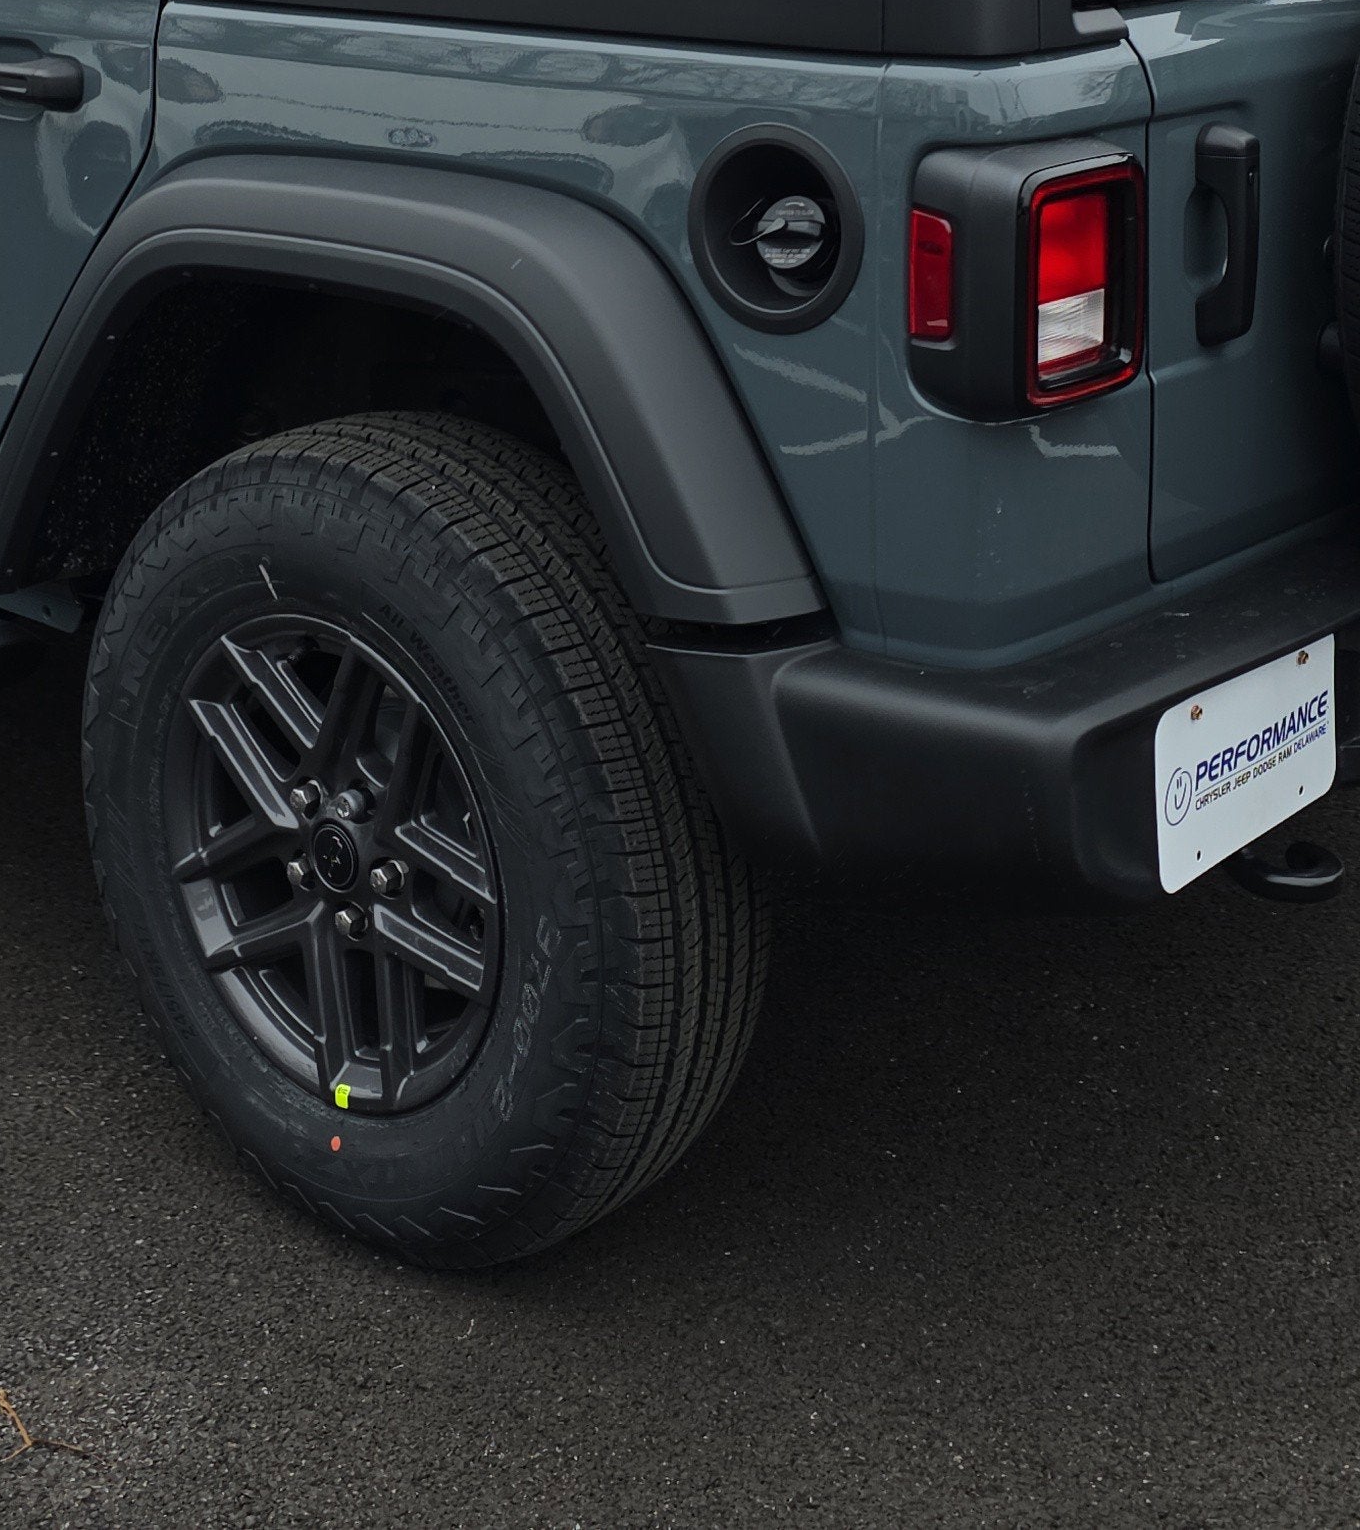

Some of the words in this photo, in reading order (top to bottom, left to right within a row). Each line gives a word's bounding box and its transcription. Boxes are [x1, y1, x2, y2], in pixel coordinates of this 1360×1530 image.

[1195, 690, 1329, 791] PERFORMANCE
[1195, 779, 1231, 811] CHRYSLER
[1233, 770, 1252, 790] JEEP
[1253, 756, 1277, 779] DODGE
[1278, 746, 1293, 763] RAM
[1293, 724, 1327, 753] DELAWARE
